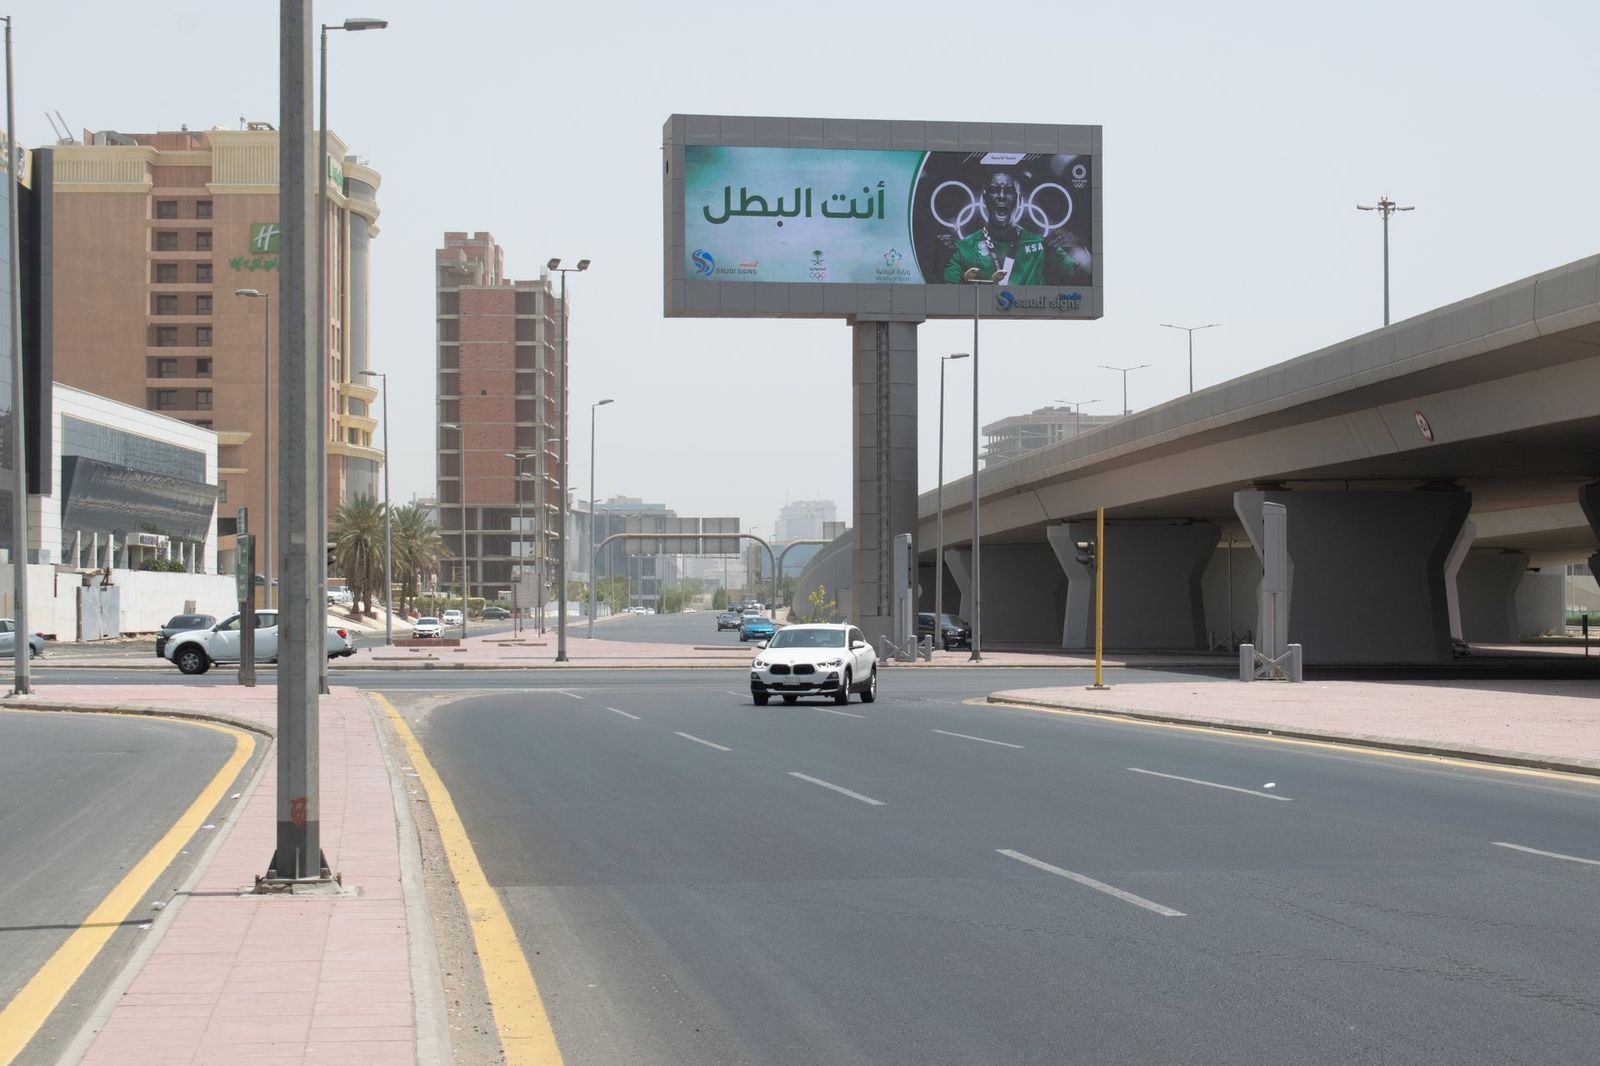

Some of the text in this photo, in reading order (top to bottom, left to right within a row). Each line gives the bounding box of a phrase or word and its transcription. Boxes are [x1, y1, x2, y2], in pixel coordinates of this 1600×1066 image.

[703, 180, 885, 228] أنت البطل
[1024, 242, 1044, 254] KSA
[1015, 296, 1081, 312] saudi signs
